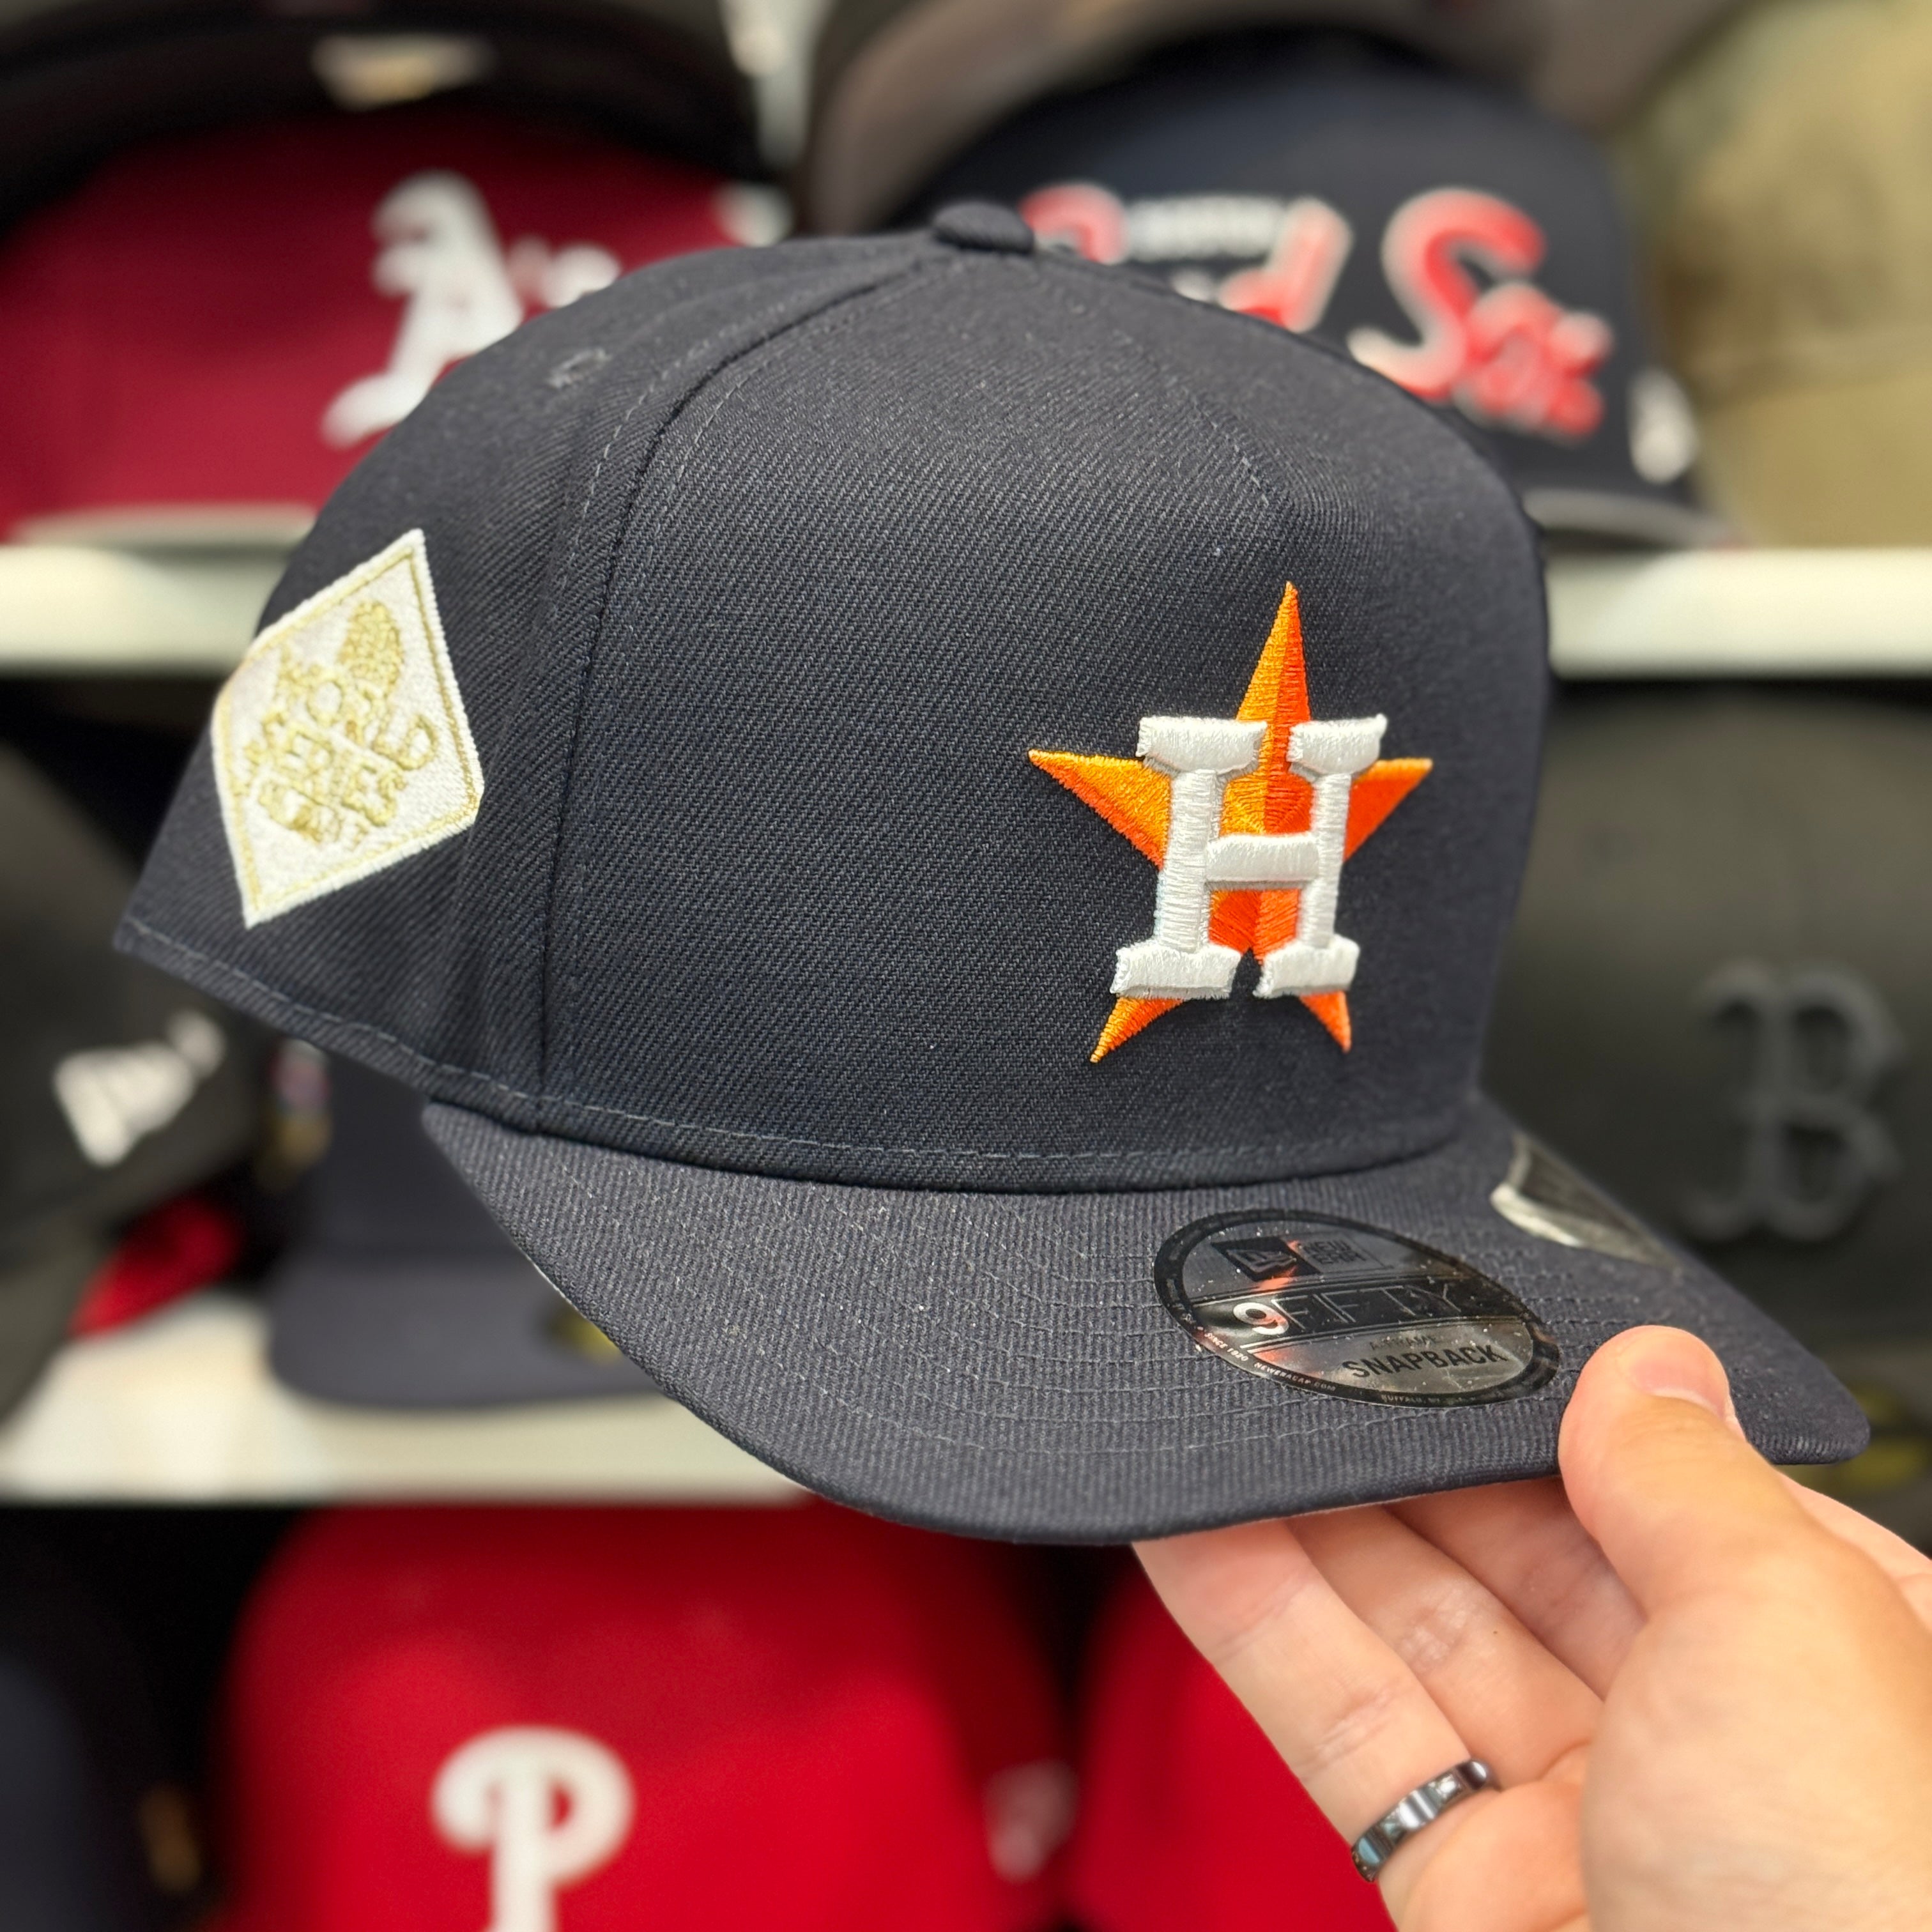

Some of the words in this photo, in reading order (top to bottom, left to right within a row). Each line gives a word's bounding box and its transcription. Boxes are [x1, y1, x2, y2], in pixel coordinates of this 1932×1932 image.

[1109, 712, 1388, 999] H
[1684, 958, 1905, 1241] B
[1204, 1332, 1228, 1349] SINCE
[1226, 1347, 1249, 1362] 1920
[1341, 1344, 1508, 1378] SNAPBACK
[429, 1724, 636, 1932] P
